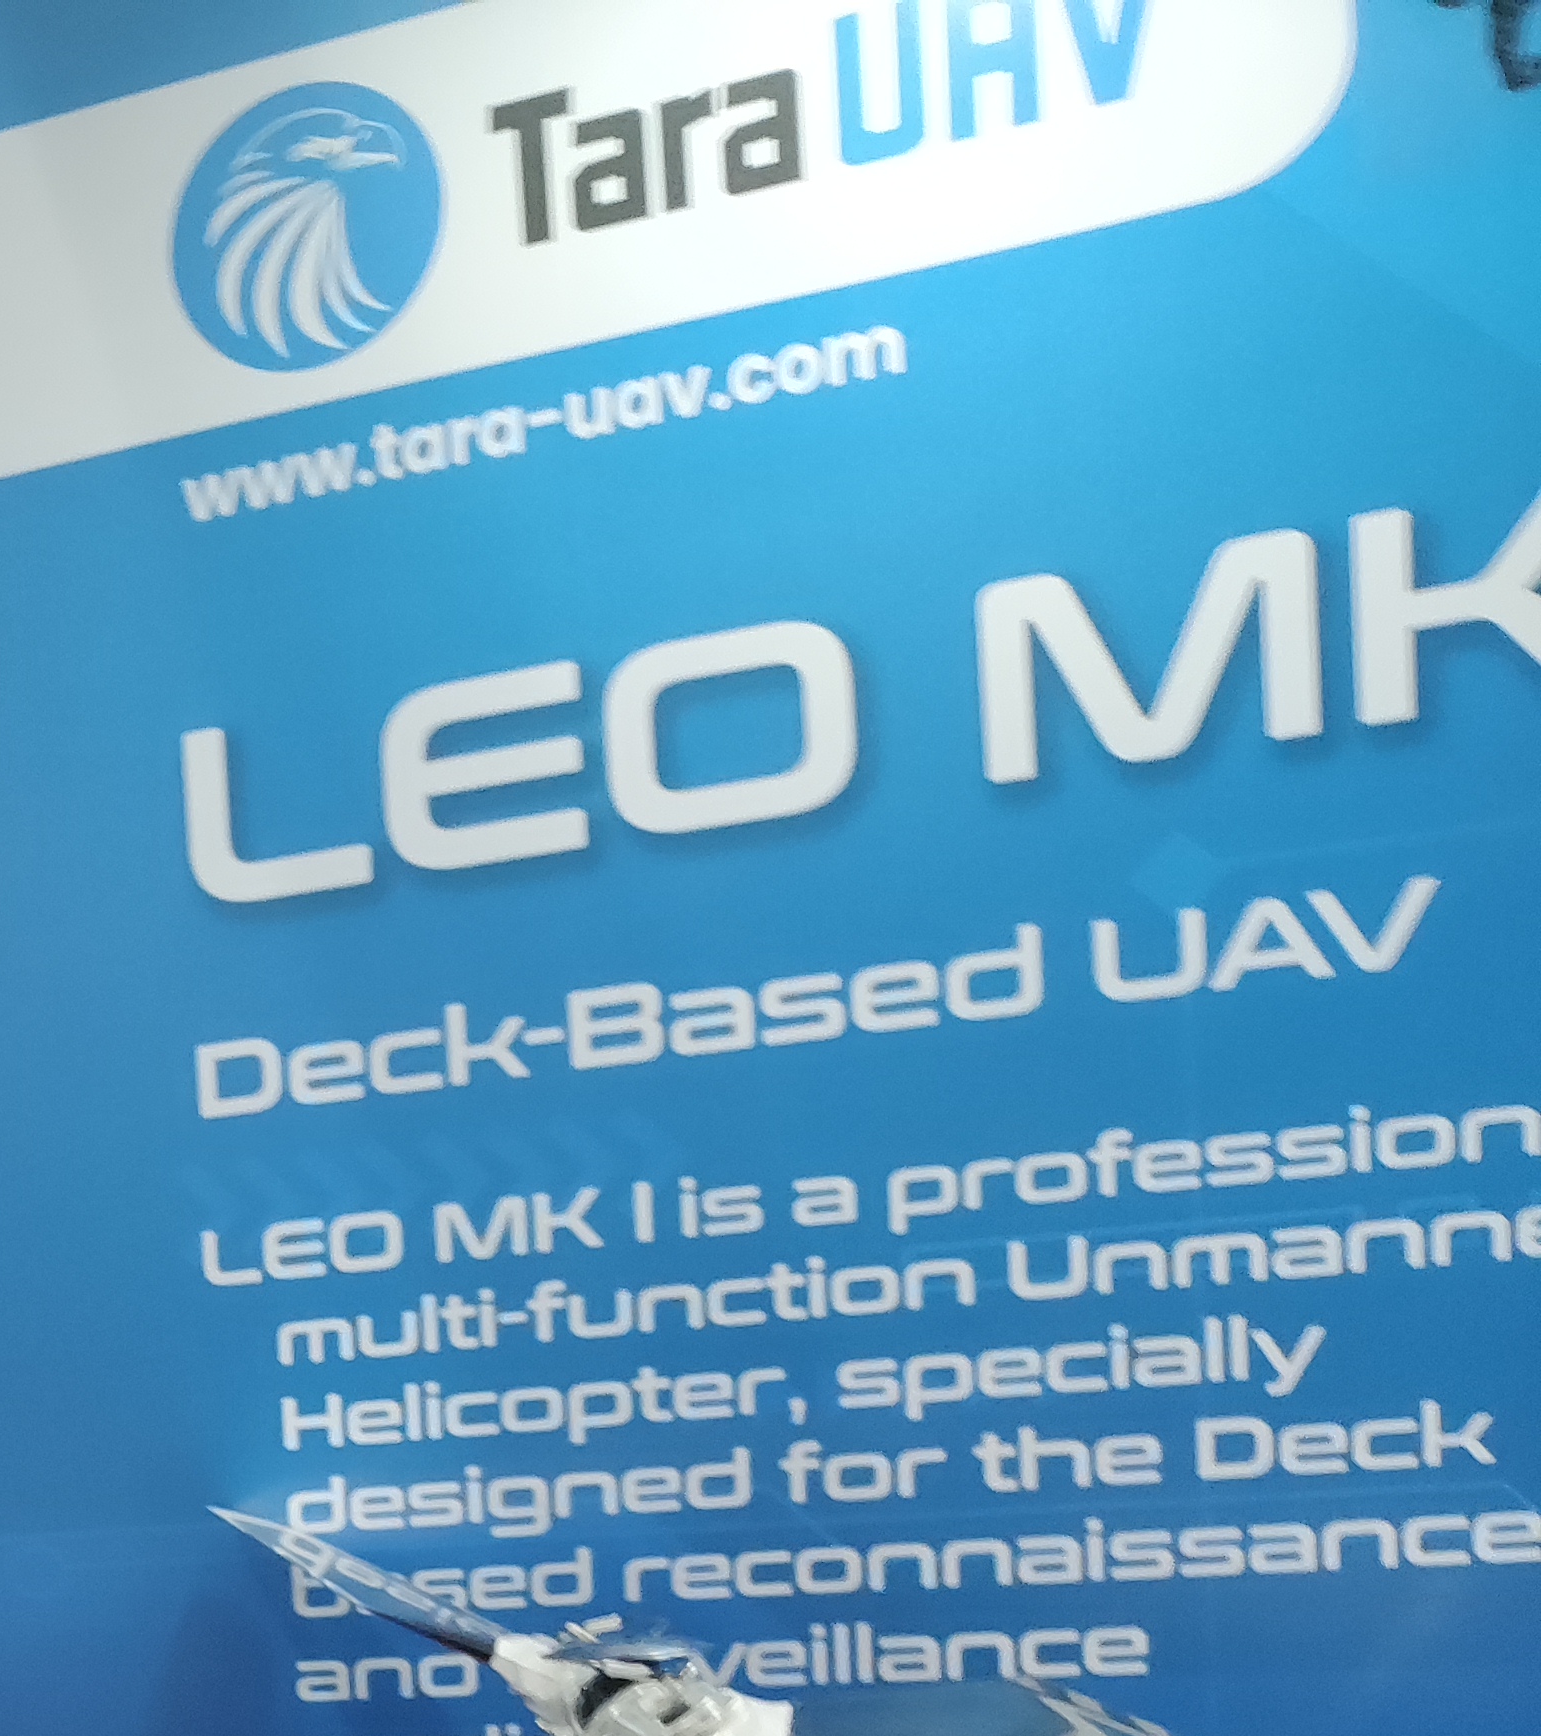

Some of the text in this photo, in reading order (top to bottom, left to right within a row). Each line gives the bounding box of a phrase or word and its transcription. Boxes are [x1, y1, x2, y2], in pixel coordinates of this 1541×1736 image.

[488, 67, 807, 246] Tara
[181, 316, 908, 523] www.tara-uav.com
[181, 491, 1541, 905] LEO MK
[195, 875, 1443, 1119] Deck-Based UAV
[200, 1209, 404, 1287] LEO
[434, 1180, 603, 1262] MK
[680, 1175, 764, 1240] is
[792, 1174, 858, 1231] a
[887, 1103, 1541, 1235] profession
[278, 1253, 977, 1366] multi-function
[280, 1313, 1327, 1454] Helicopter, specially
[286, 1398, 1497, 1538] designed for the Deck
[290, 1506, 1541, 1618] bsed reconnaissance
[692, 1620, 1152, 1690] veillance
